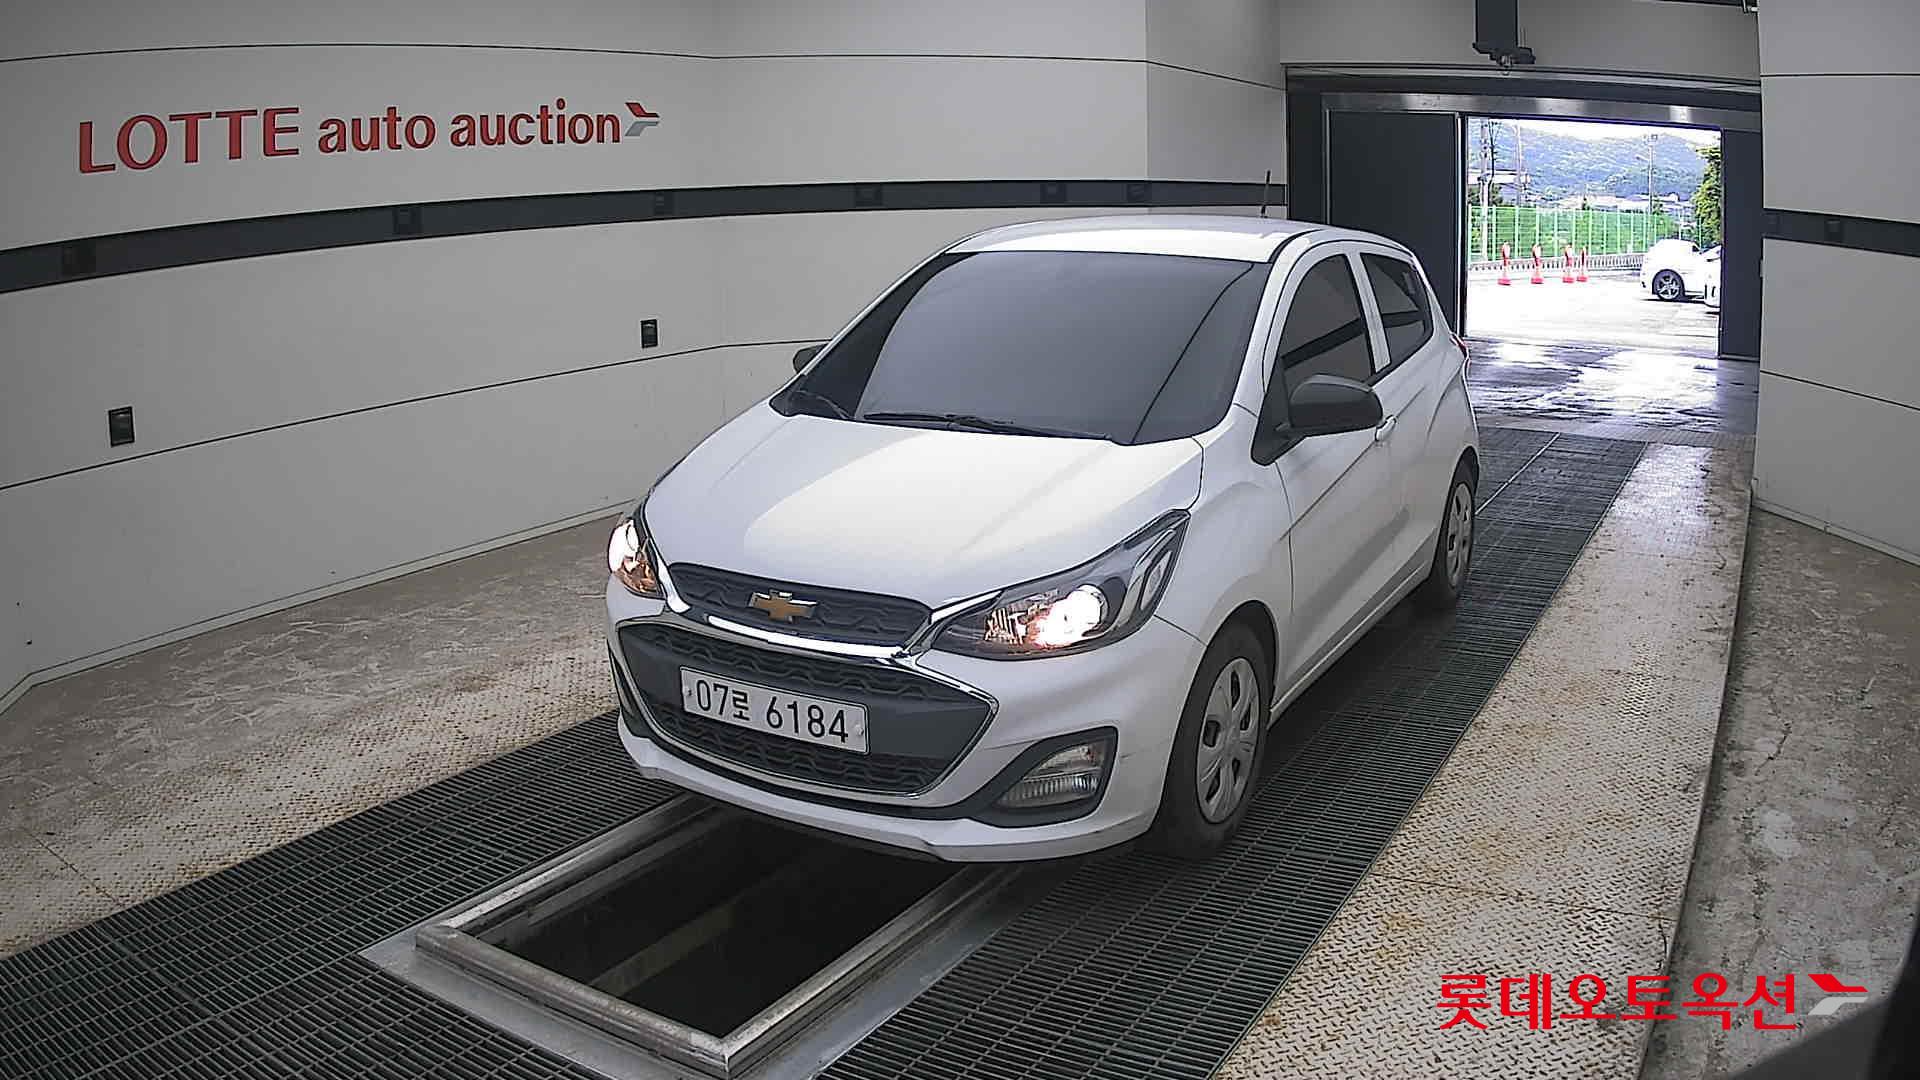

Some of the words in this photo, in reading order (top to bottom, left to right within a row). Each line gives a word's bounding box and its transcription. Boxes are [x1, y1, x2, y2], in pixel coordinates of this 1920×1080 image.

[79, 106, 300, 174] LOTTE
[317, 106, 436, 154] auto
[449, 98, 621, 147] auction
[696, 679, 750, 721] 07로
[766, 696, 848, 743] 6184
